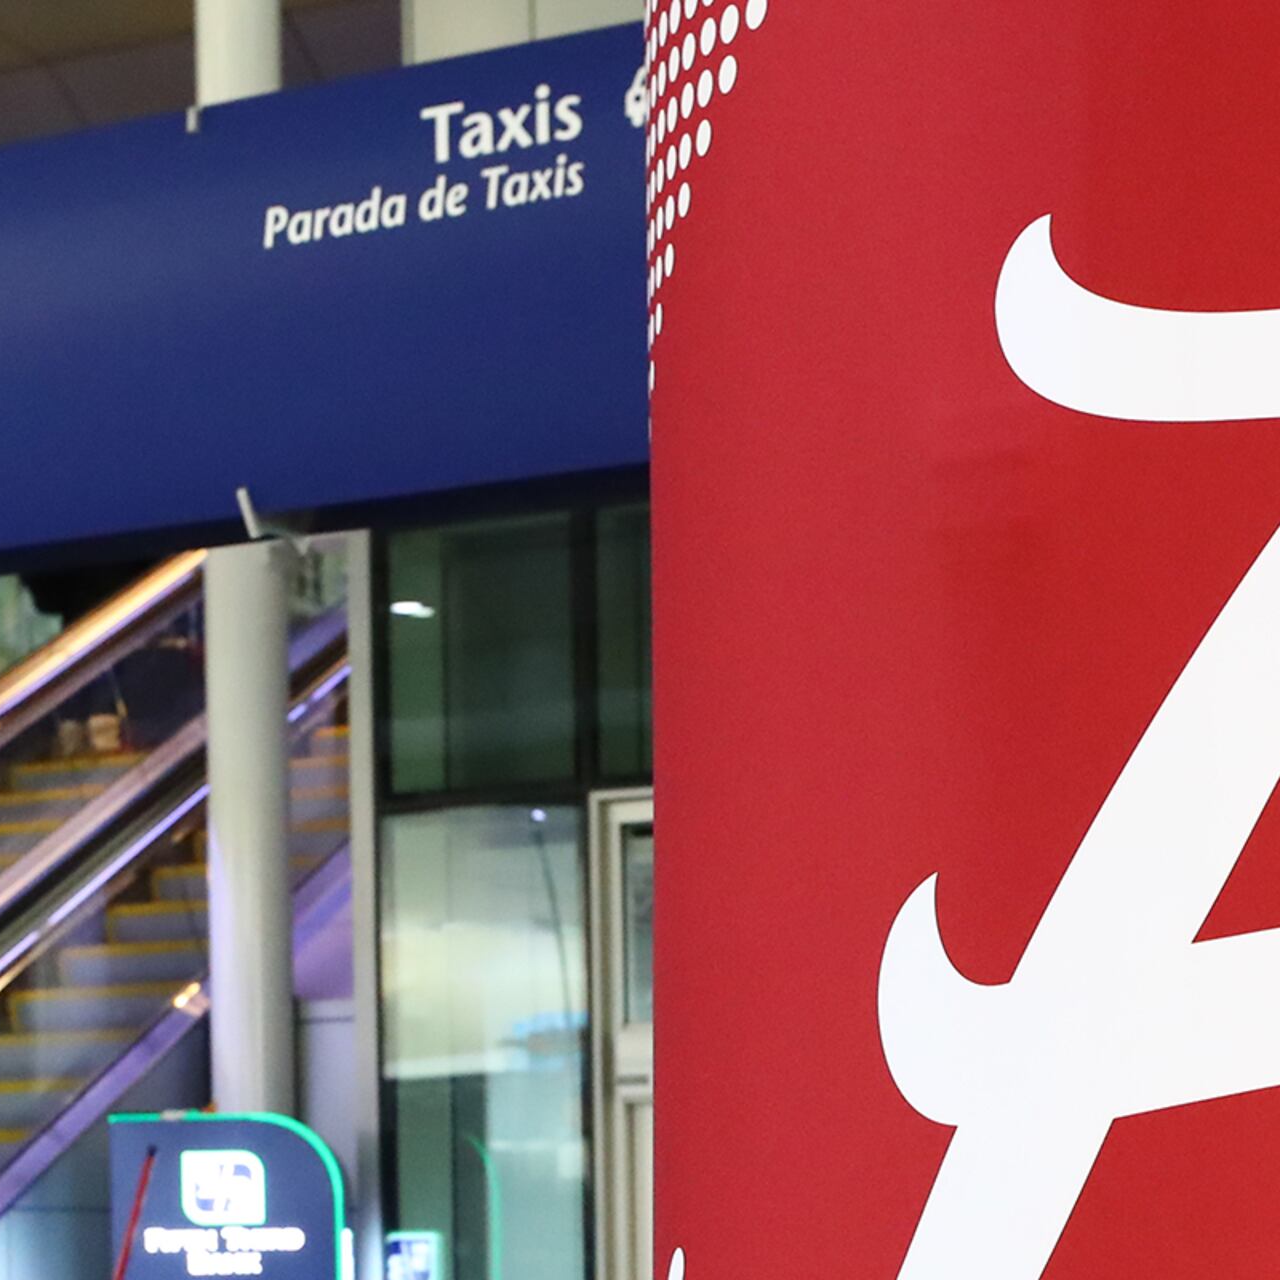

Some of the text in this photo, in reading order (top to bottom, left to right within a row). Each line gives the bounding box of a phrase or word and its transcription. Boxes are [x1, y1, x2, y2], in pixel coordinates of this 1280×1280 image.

[420, 83, 584, 164] Taxis
[263, 153, 586, 250] Parada de Taxis
